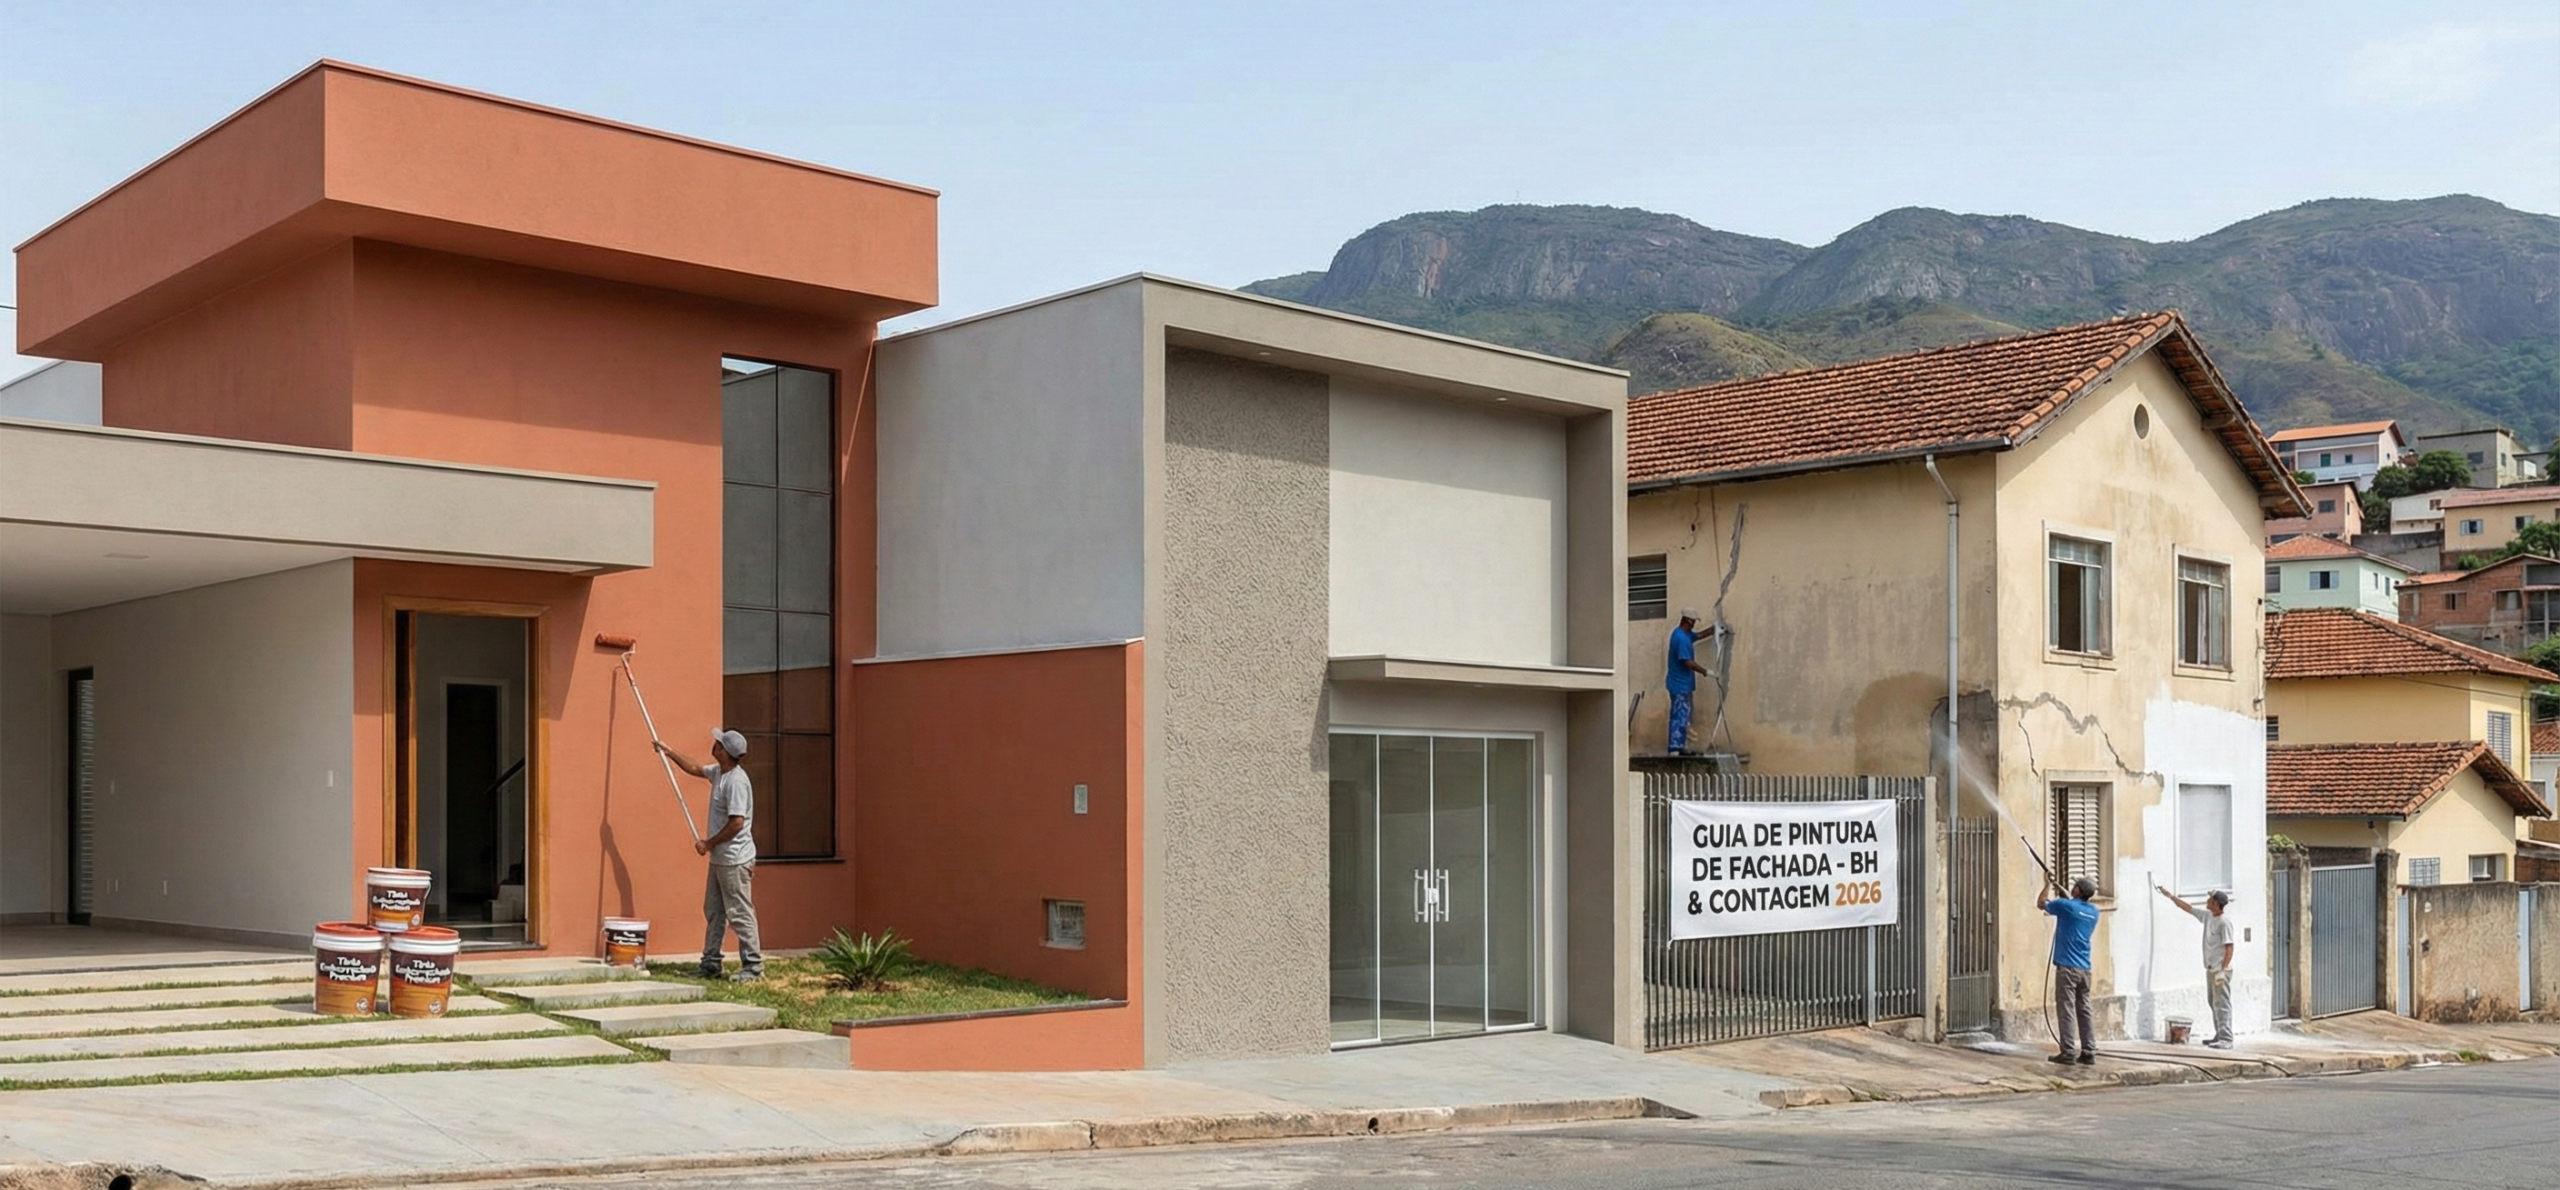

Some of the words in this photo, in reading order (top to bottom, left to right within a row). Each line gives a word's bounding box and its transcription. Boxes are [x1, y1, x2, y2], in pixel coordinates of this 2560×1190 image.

[1692, 824, 1748, 849] GUIA
[1754, 822, 1783, 847] DE
[1788, 820, 1878, 846] PINTURA
[1692, 857, 1723, 882] DE
[1729, 852, 1833, 880] FACHADA
[1850, 850, 1878, 875] BH
[1687, 890, 1703, 916] &
[1709, 883, 1830, 914] CONTAGEM
[1835, 880, 1883, 907] 2026
